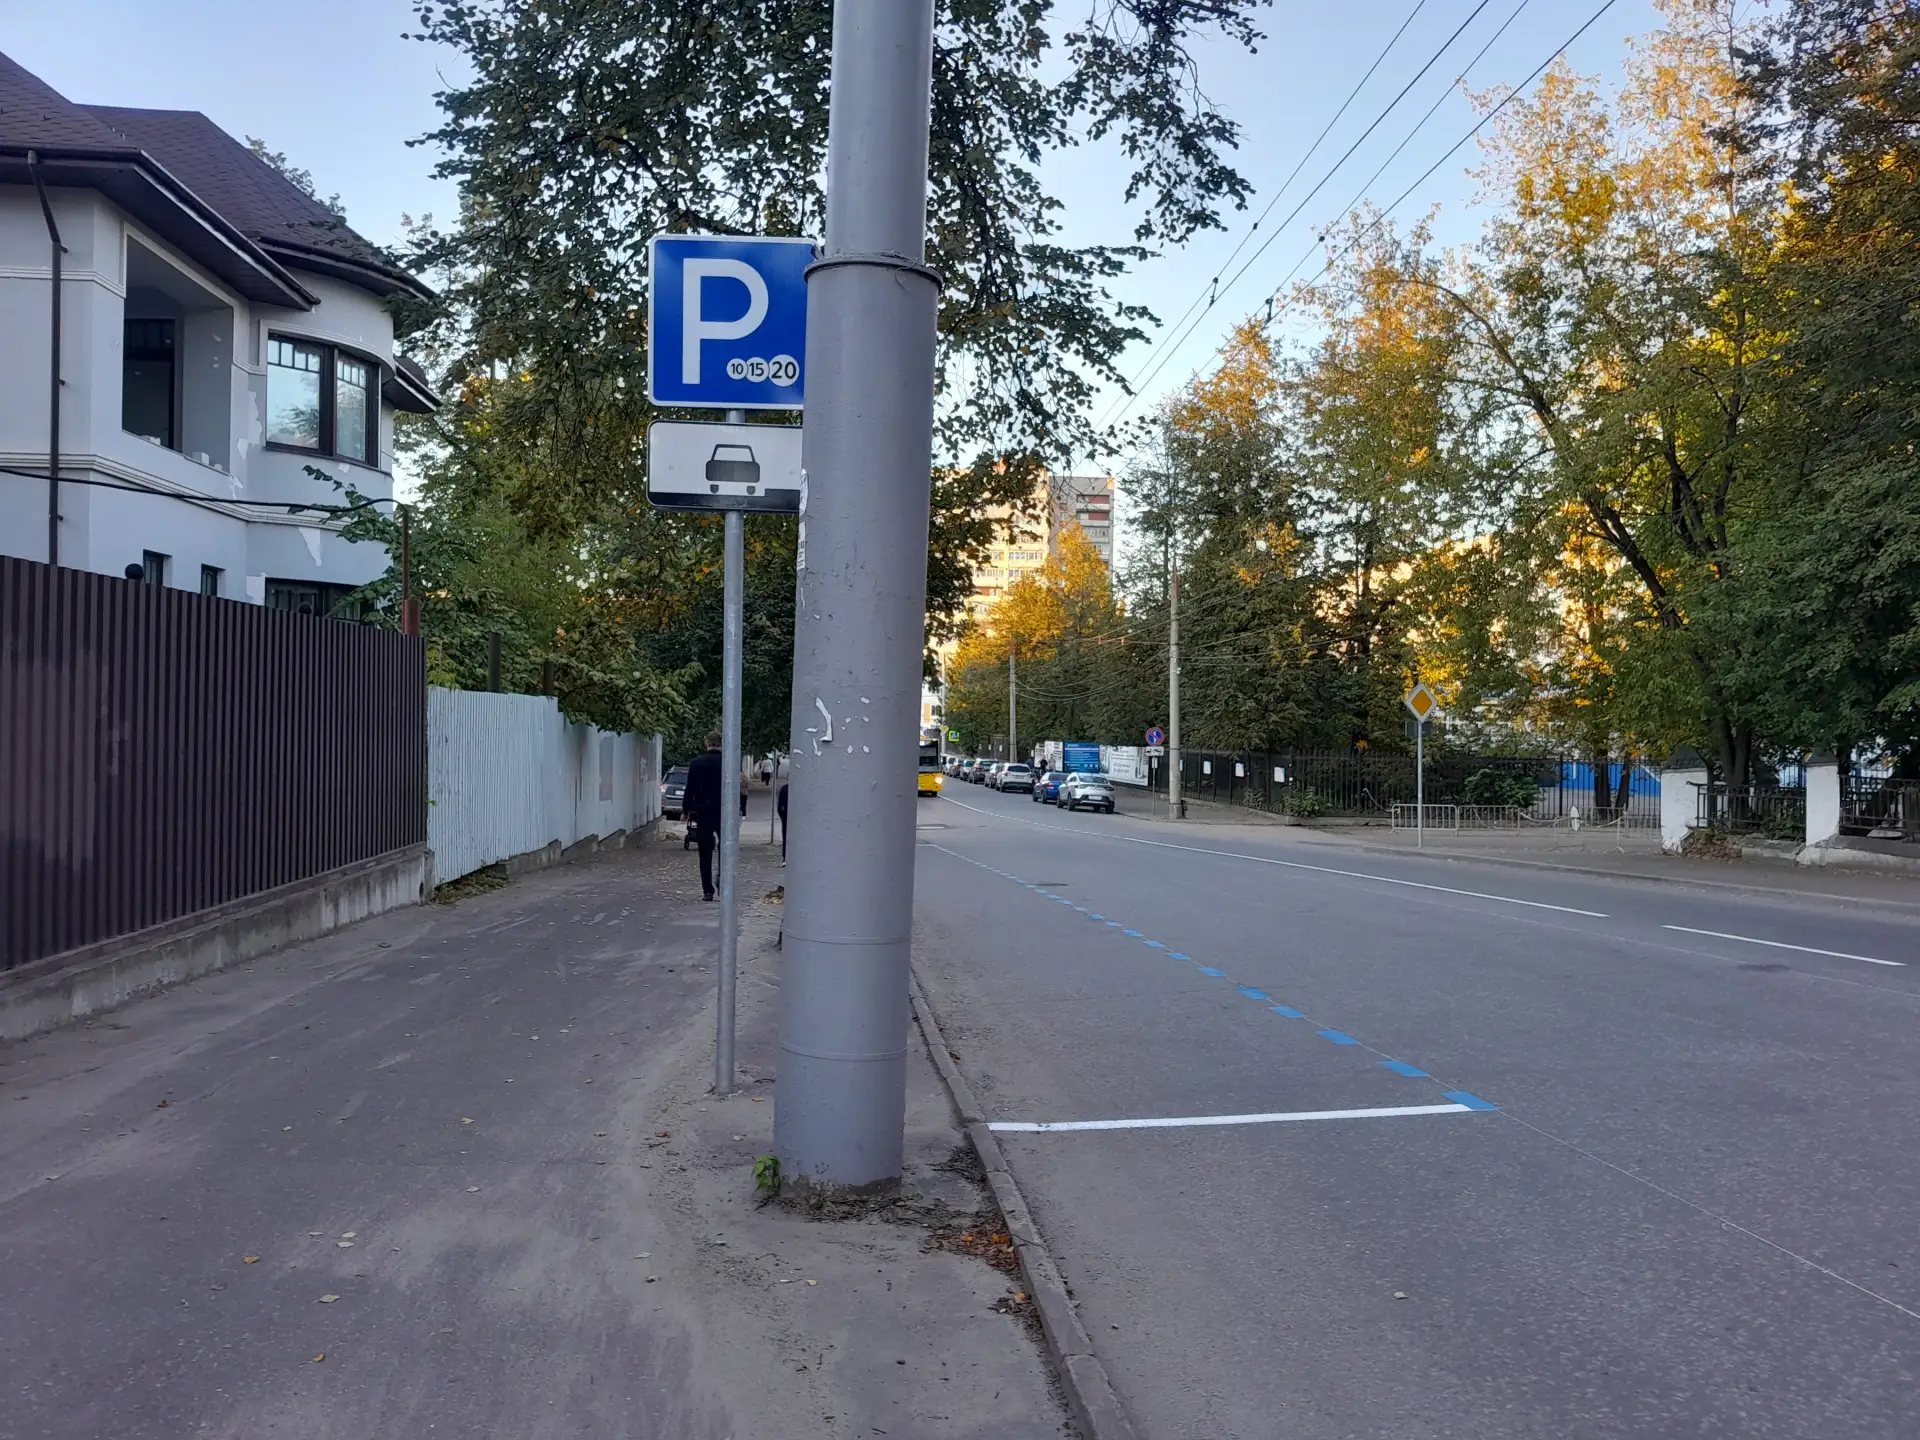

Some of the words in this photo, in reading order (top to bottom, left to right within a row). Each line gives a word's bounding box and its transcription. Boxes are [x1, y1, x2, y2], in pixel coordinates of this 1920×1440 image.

[682, 258, 769, 384] P
[730, 363, 744, 375] 10
[749, 362, 765, 377] 15
[771, 361, 796, 379] 20
